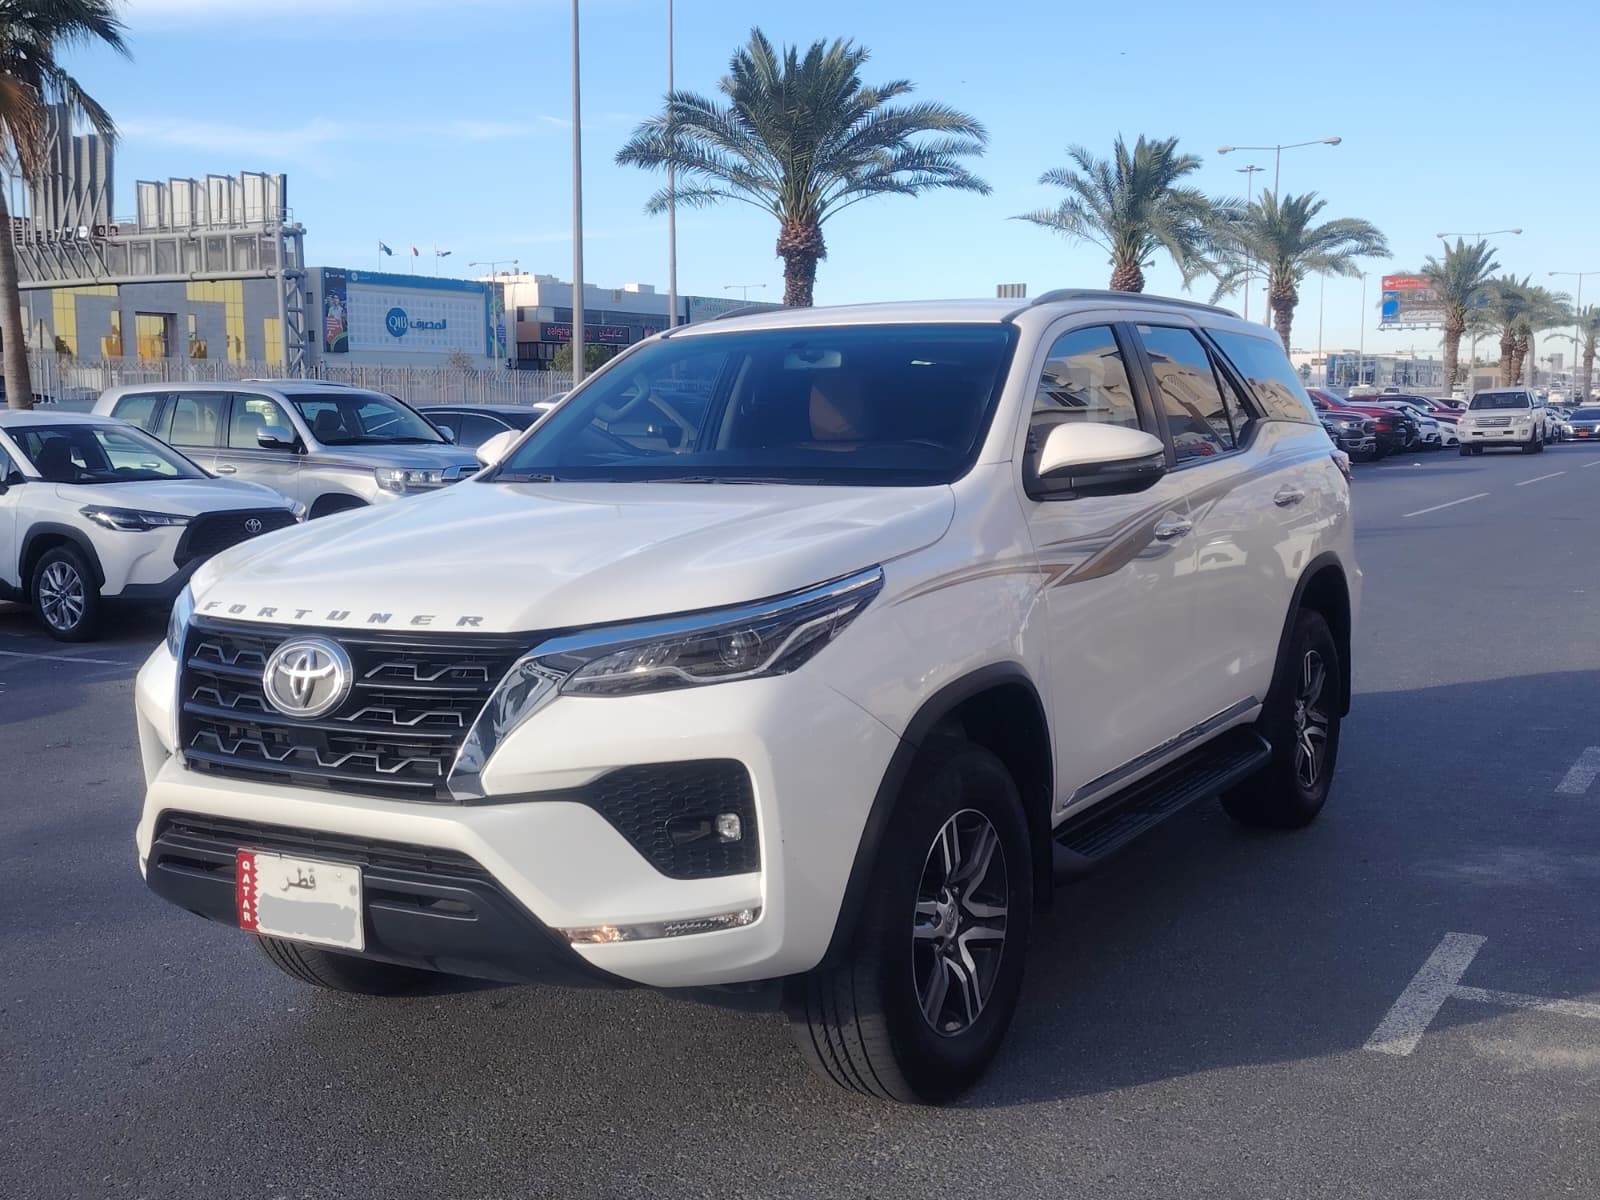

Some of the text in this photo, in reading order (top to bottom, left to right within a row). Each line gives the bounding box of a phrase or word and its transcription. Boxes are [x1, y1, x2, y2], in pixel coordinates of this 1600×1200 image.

[409, 318, 447, 331] المصرف
[203, 601, 485, 627] FORTUNER
[242, 860, 252, 922] QATAR
[280, 866, 317, 892] قطر
